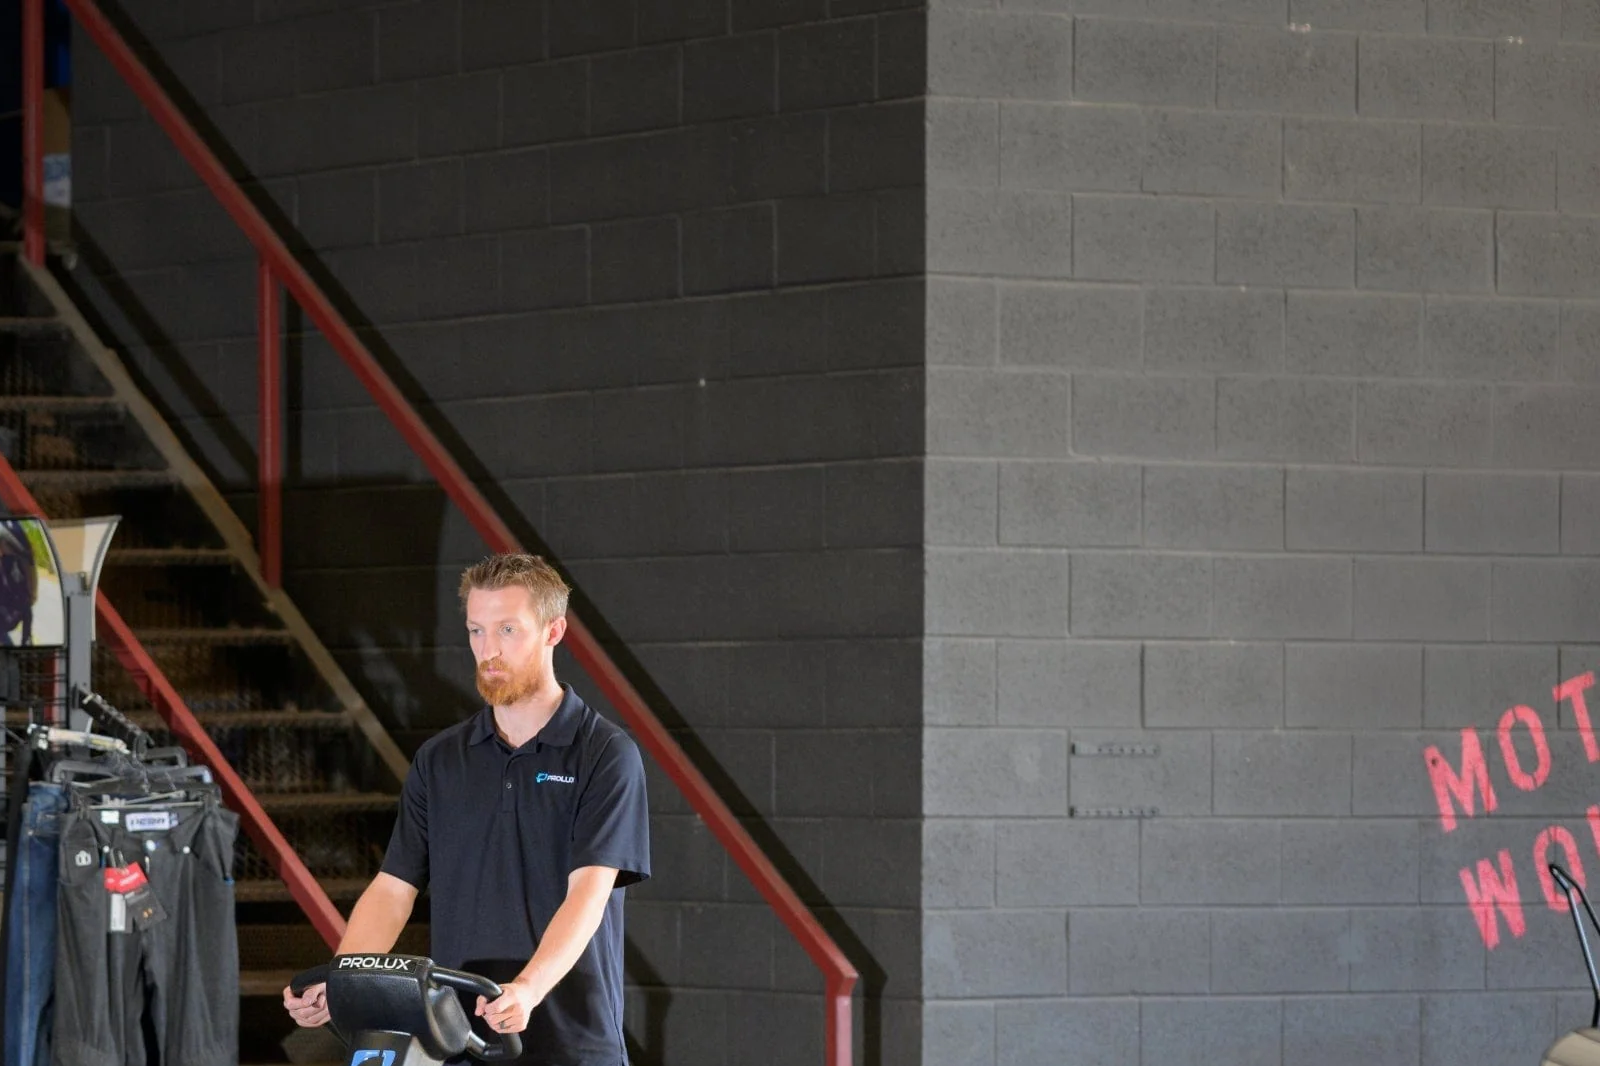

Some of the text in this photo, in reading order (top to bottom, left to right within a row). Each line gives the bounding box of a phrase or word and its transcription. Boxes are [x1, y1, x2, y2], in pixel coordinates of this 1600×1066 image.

[1423, 668, 1600, 834] MOT
[1458, 804, 1600, 951] WO
[338, 957, 411, 971] PROLUX
